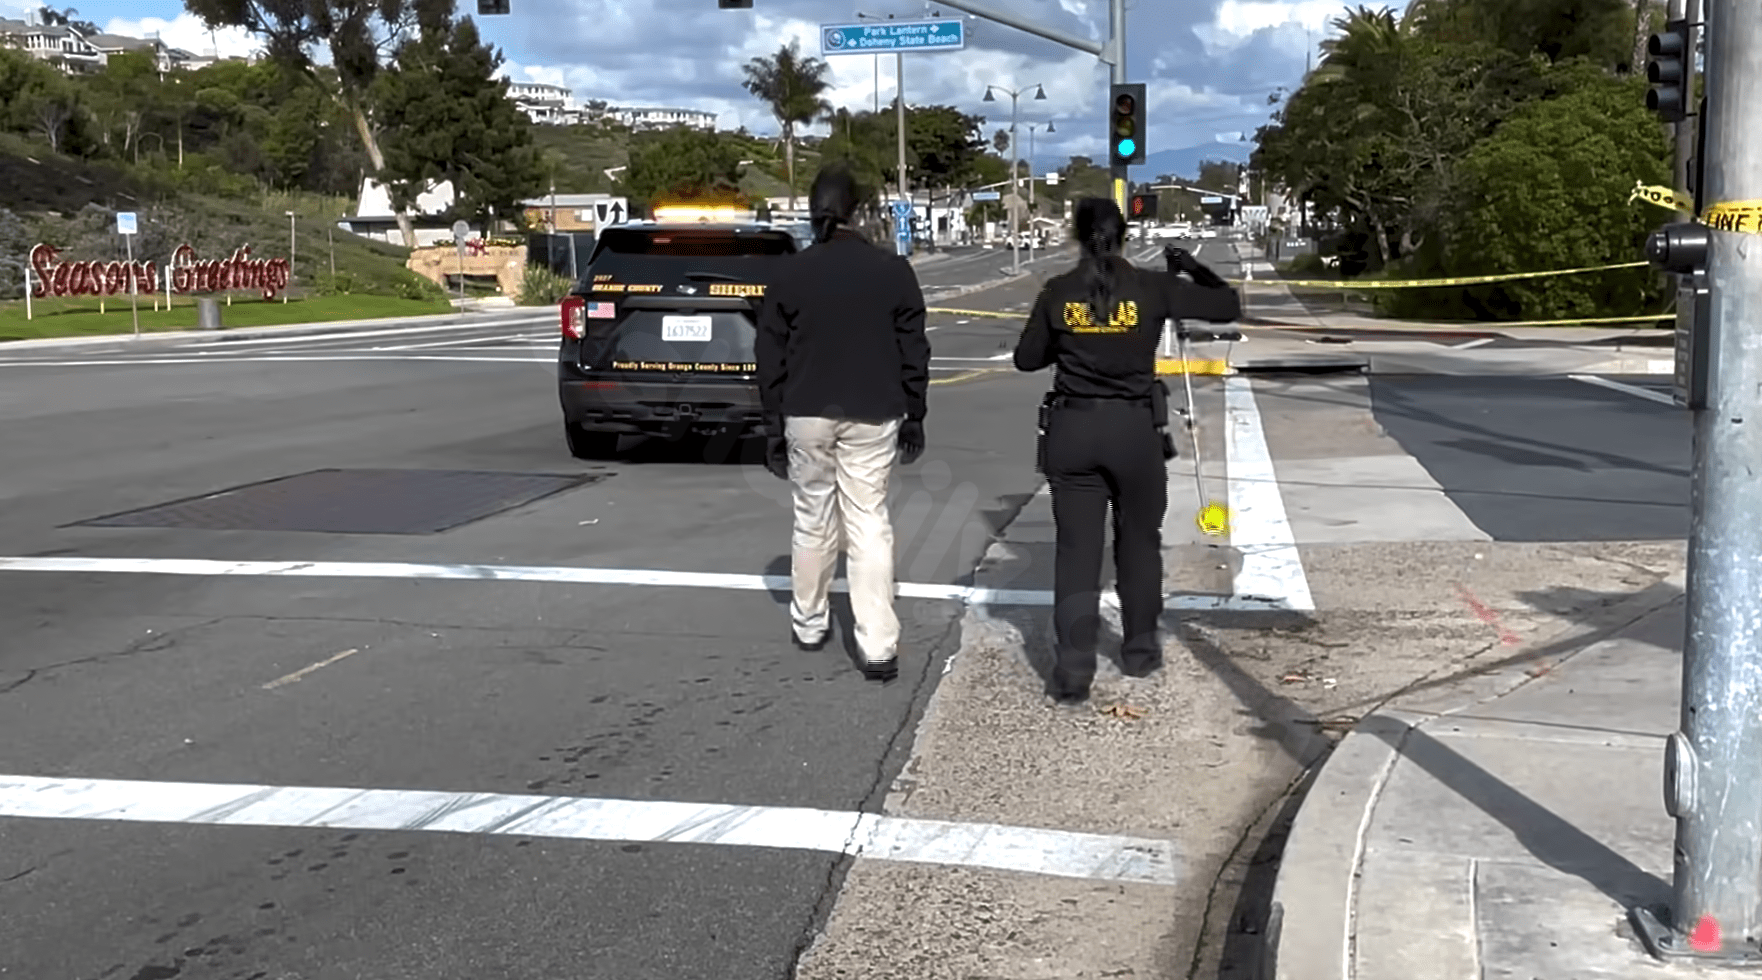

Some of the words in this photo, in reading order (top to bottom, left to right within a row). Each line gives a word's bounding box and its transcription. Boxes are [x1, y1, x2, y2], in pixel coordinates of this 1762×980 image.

[864, 26, 887, 36] Park
[890, 25, 928, 36] Lantern
[859, 37, 897, 47] Doheny
[898, 35, 925, 46] State
[928, 33, 958, 44] Beach
[171, 243, 290, 300] Greetings
[591, 284, 626, 292] ORANGE
[627, 284, 664, 292] COUNTY
[709, 284, 767, 296] SHERI
[1108, 301, 1138, 326] LAB
[613, 361, 639, 371] Proudly
[640, 361, 667, 372] Serving
[667, 362, 693, 371] Orange
[694, 362, 719, 372] County
[720, 362, 740, 371] Since
